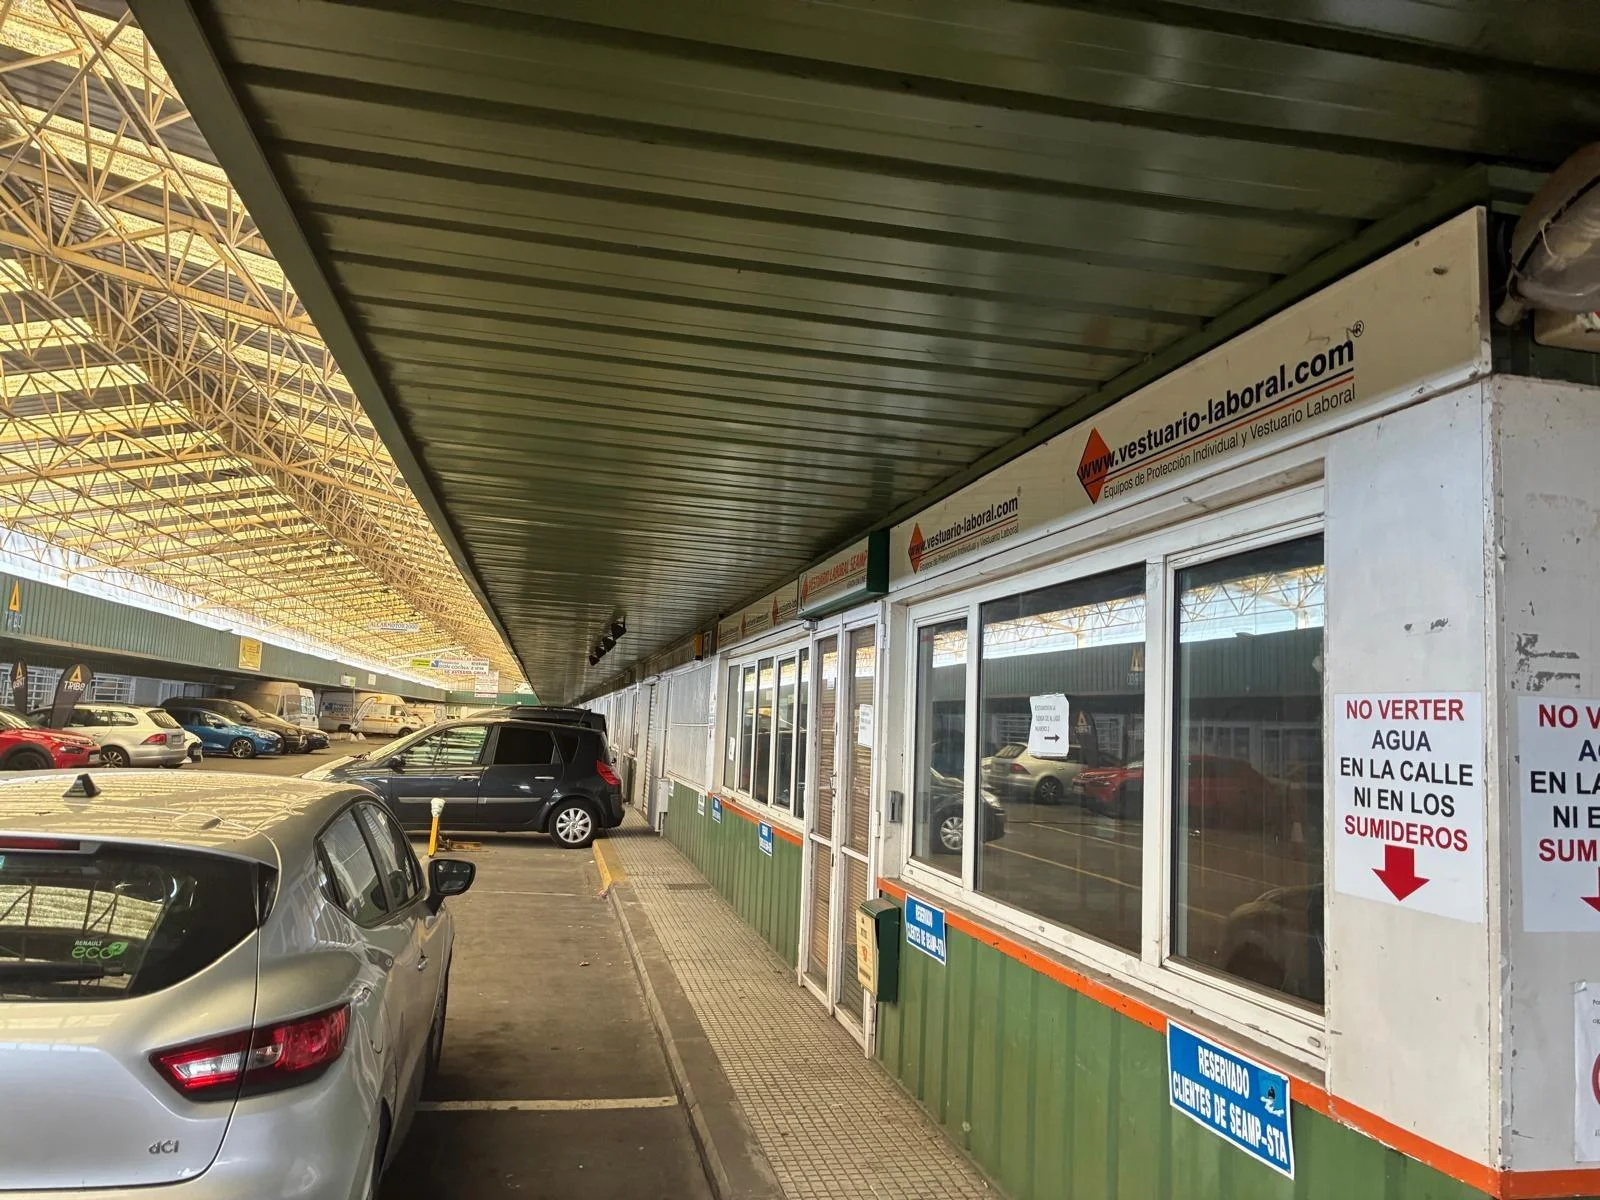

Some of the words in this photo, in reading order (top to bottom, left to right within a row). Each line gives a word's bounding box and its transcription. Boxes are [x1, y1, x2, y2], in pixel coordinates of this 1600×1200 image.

[1103, 478, 1133, 499] Equipos
[1135, 473, 1145, 488] de
[1146, 453, 1191, 481] Protección
[1193, 436, 1239, 464] Individual
[1241, 432, 1248, 447] y
[1250, 408, 1303, 439] Vestuario
[1306, 384, 1356, 419] Laboral
[1346, 699, 1373, 720] NO
[1378, 699, 1465, 722] VERTER
[1538, 704, 1578, 729] NO
[1371, 729, 1432, 752] AGUA
[1340, 757, 1364, 778] EN
[1369, 759, 1395, 780] LA
[1400, 760, 1474, 787] CALLE
[1530, 771, 1567, 794] EN
[1353, 786, 1371, 808] NI
[1377, 788, 1403, 812] EN
[1410, 792, 1455, 818] LOS
[1553, 805, 1578, 829] NI
[1344, 814, 1468, 852] SUMIDEROS
[1197, 1045, 1250, 1100] RESERVADO
[1172, 1070, 1212, 1119] CLIENTES
[1214, 1093, 1227, 1129] DE
[1229, 1102, 1289, 1165] SEAMP-STA
